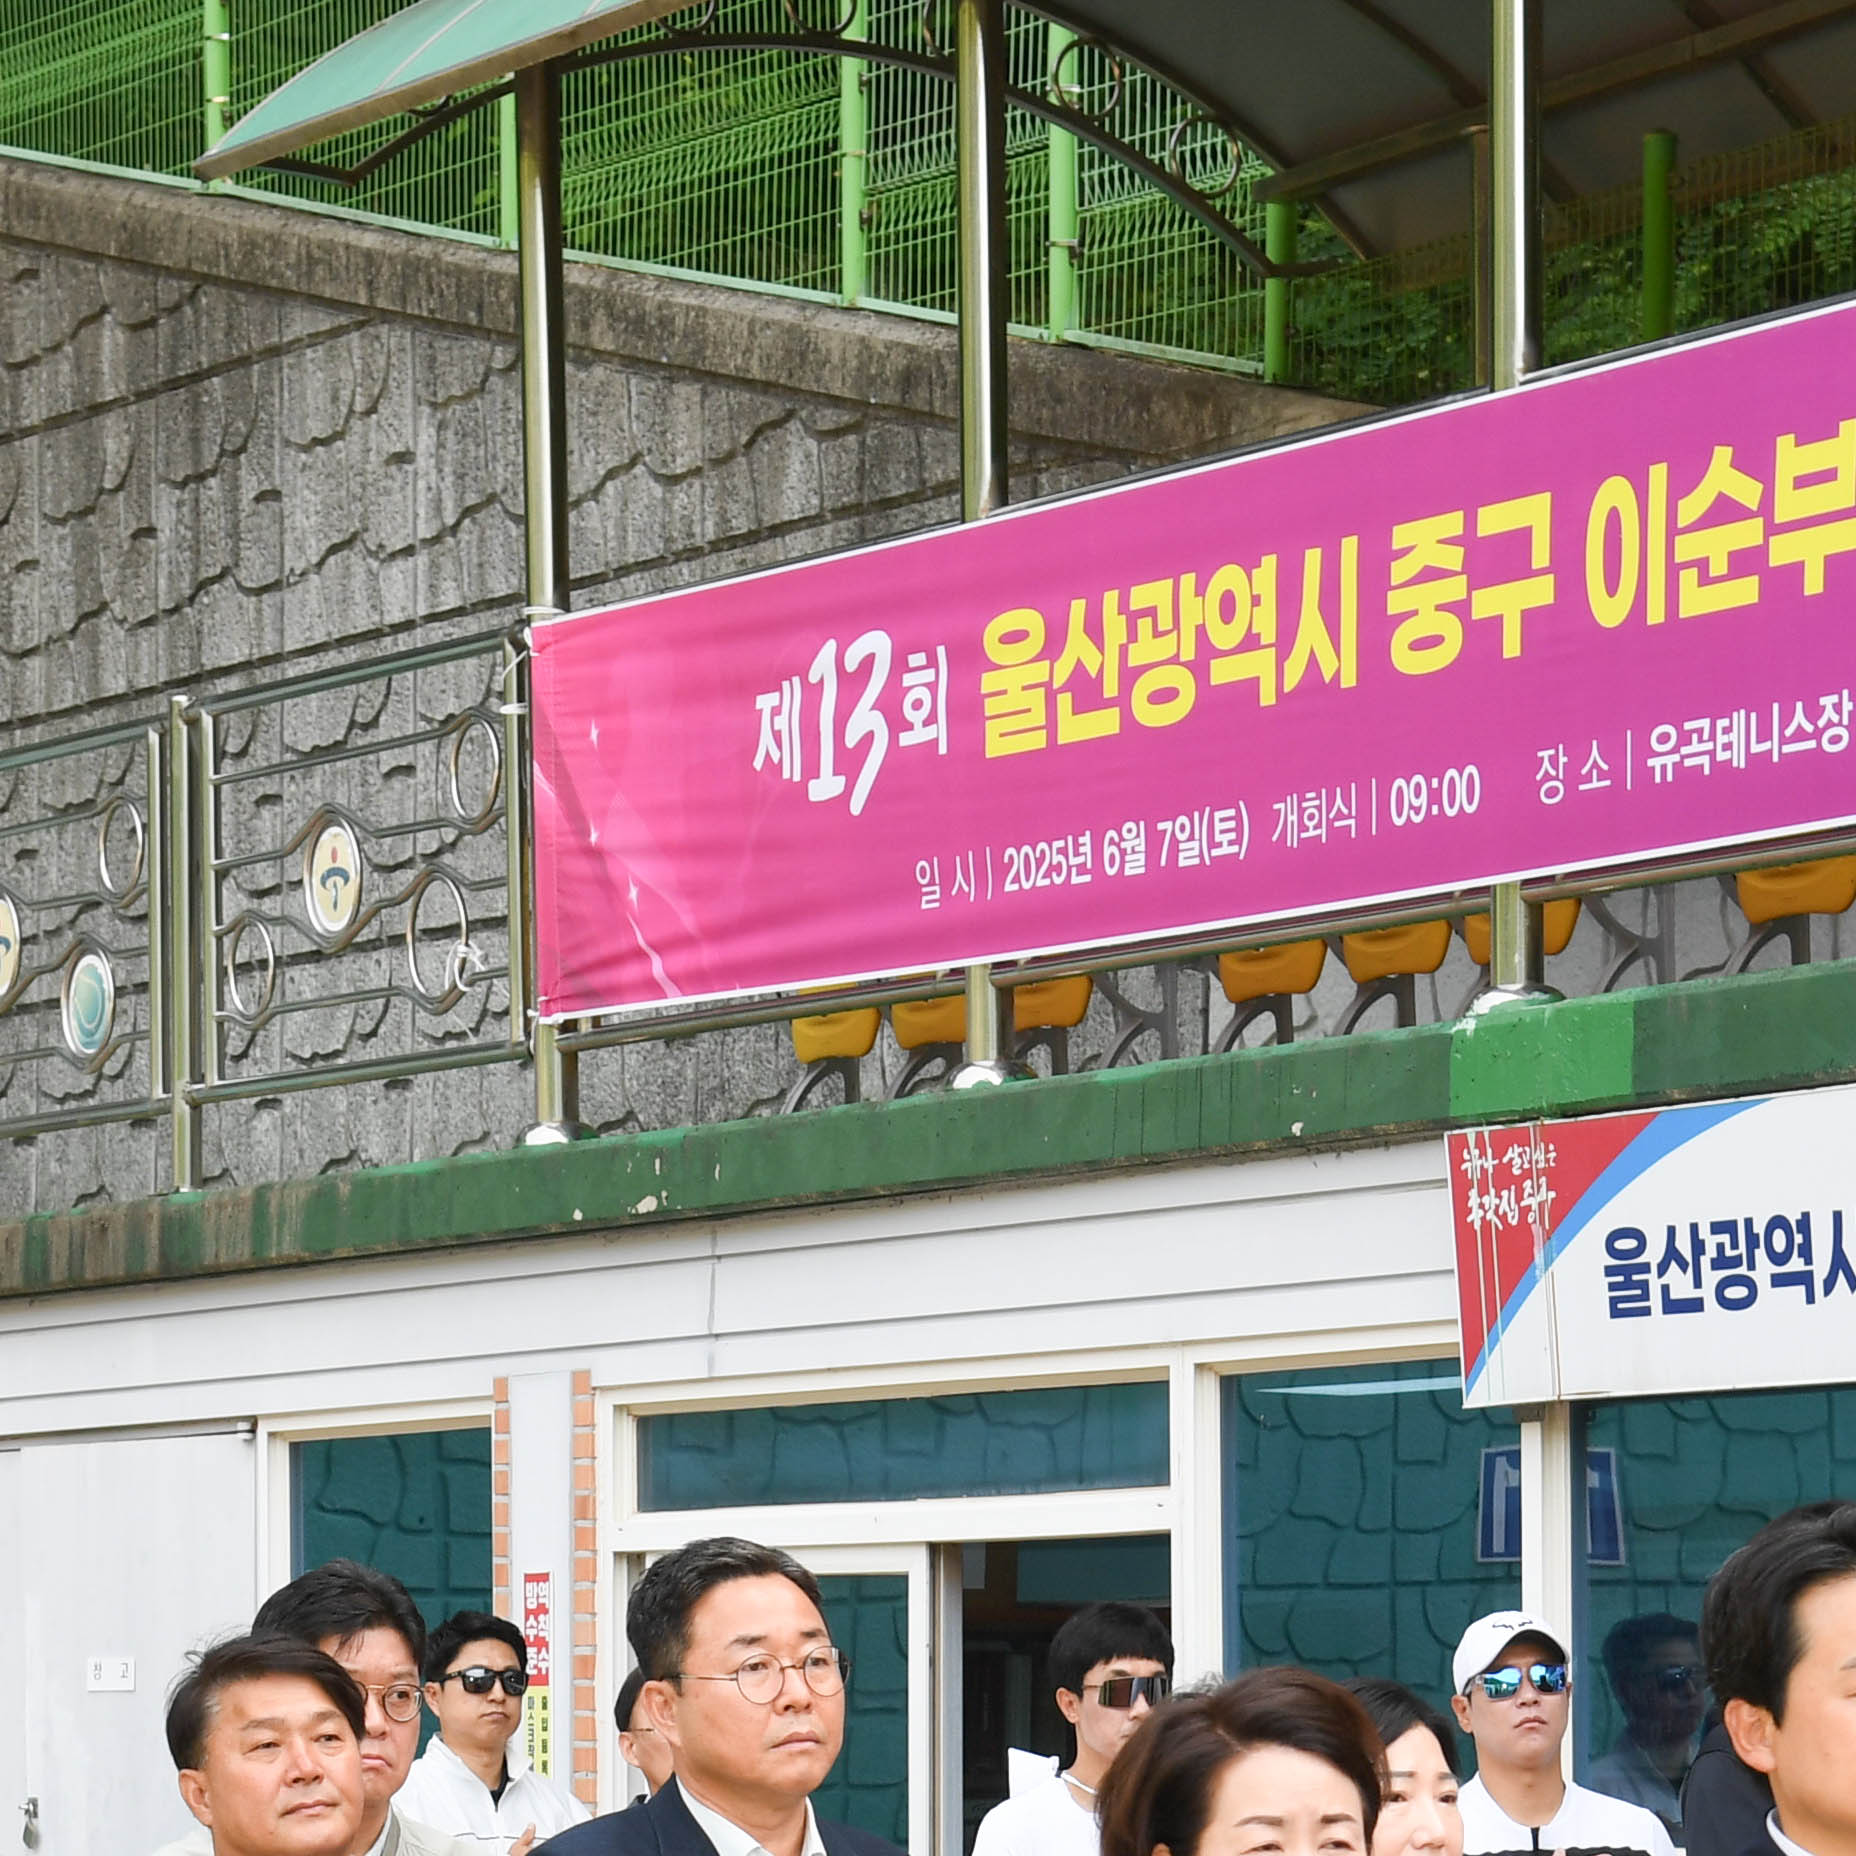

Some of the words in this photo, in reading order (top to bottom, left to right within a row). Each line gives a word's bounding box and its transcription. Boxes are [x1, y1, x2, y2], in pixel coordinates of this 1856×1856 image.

[753, 629, 948, 817] 제13회
[981, 535, 1358, 759] 울산광역시
[1387, 491, 1555, 676] 중구
[1003, 829, 1092, 893] 2025년
[1103, 820, 1146, 877] 6월
[1156, 802, 1250, 869] 7일(토)
[1271, 784, 1357, 850] 개회식
[1390, 764, 1481, 827] 09:00
[1646, 688, 1854, 785] 유곡테니스장
